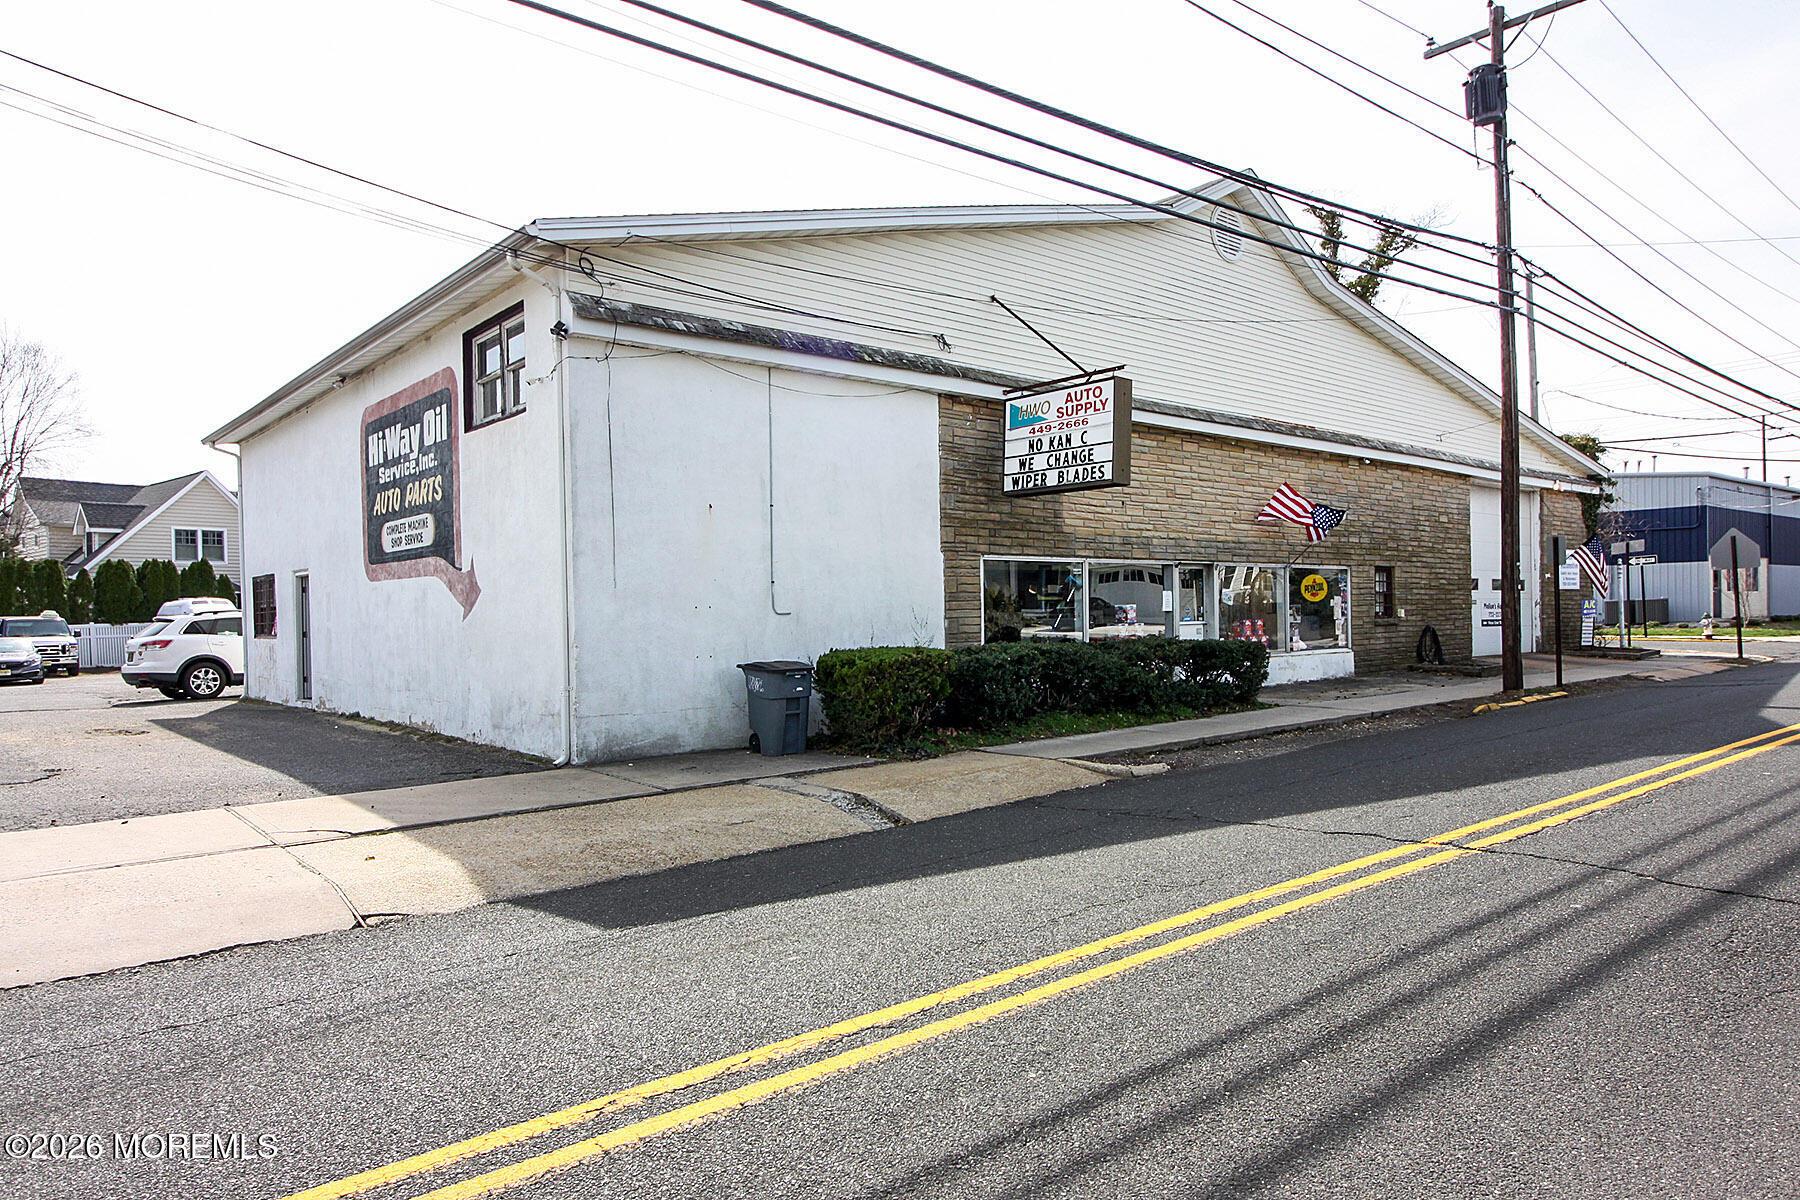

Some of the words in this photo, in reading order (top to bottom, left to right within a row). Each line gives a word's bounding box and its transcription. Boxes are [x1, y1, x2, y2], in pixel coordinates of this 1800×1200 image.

[1065, 386, 1103, 404] AUTO
[1018, 400, 1051, 420] HWO
[1056, 398, 1109, 419] SUPPLY
[423, 403, 447, 446] Oil
[1028, 417, 1089, 435] 449-2666
[1028, 438, 1043, 453] NO
[1049, 433, 1072, 450] KAN
[1080, 430, 1088, 444] C
[1018, 457, 1035, 471] WE
[1046, 447, 1094, 467] CHANGE
[1012, 472, 1047, 490] WIPER
[1057, 465, 1105, 484] BLADES
[373, 487, 401, 516] AUTO
[405, 474, 443, 508] PARTS
[386, 522, 407, 536] COMPLETE
[407, 517, 429, 532] MACHINE
[391, 536, 402, 548] SHOP
[404, 532, 424, 546] SERVICE
